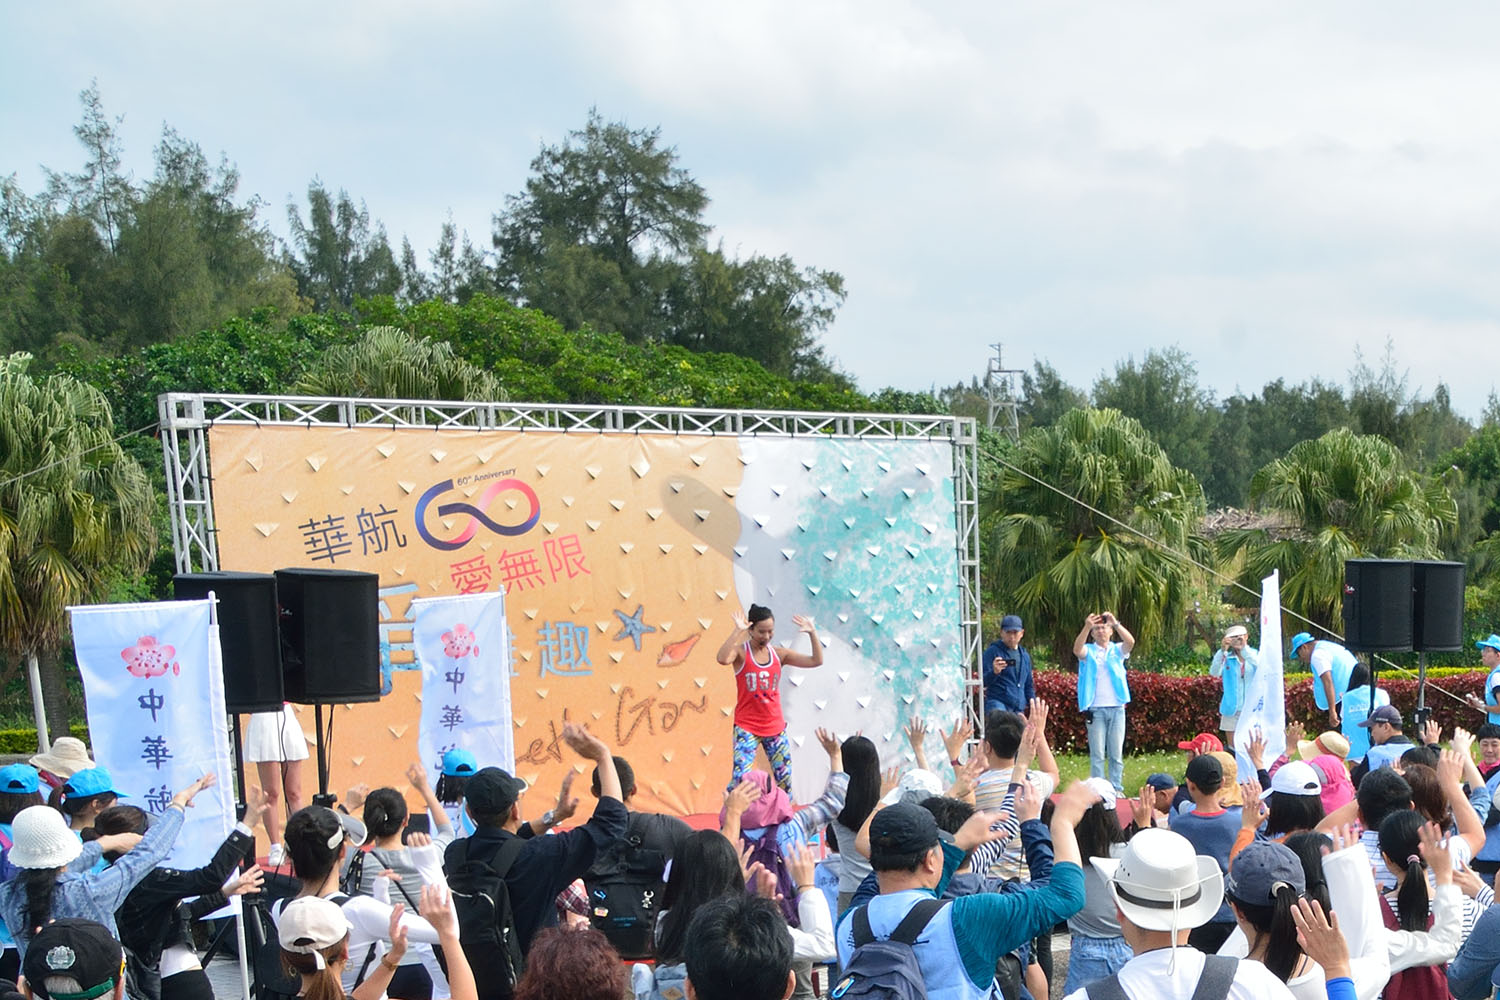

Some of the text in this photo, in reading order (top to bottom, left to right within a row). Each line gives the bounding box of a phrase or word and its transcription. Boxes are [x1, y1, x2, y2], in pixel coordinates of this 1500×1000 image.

[474, 468, 517, 483] Anniversary
[298, 504, 408, 563] 華航
[450, 534, 591, 594] 愛無限
